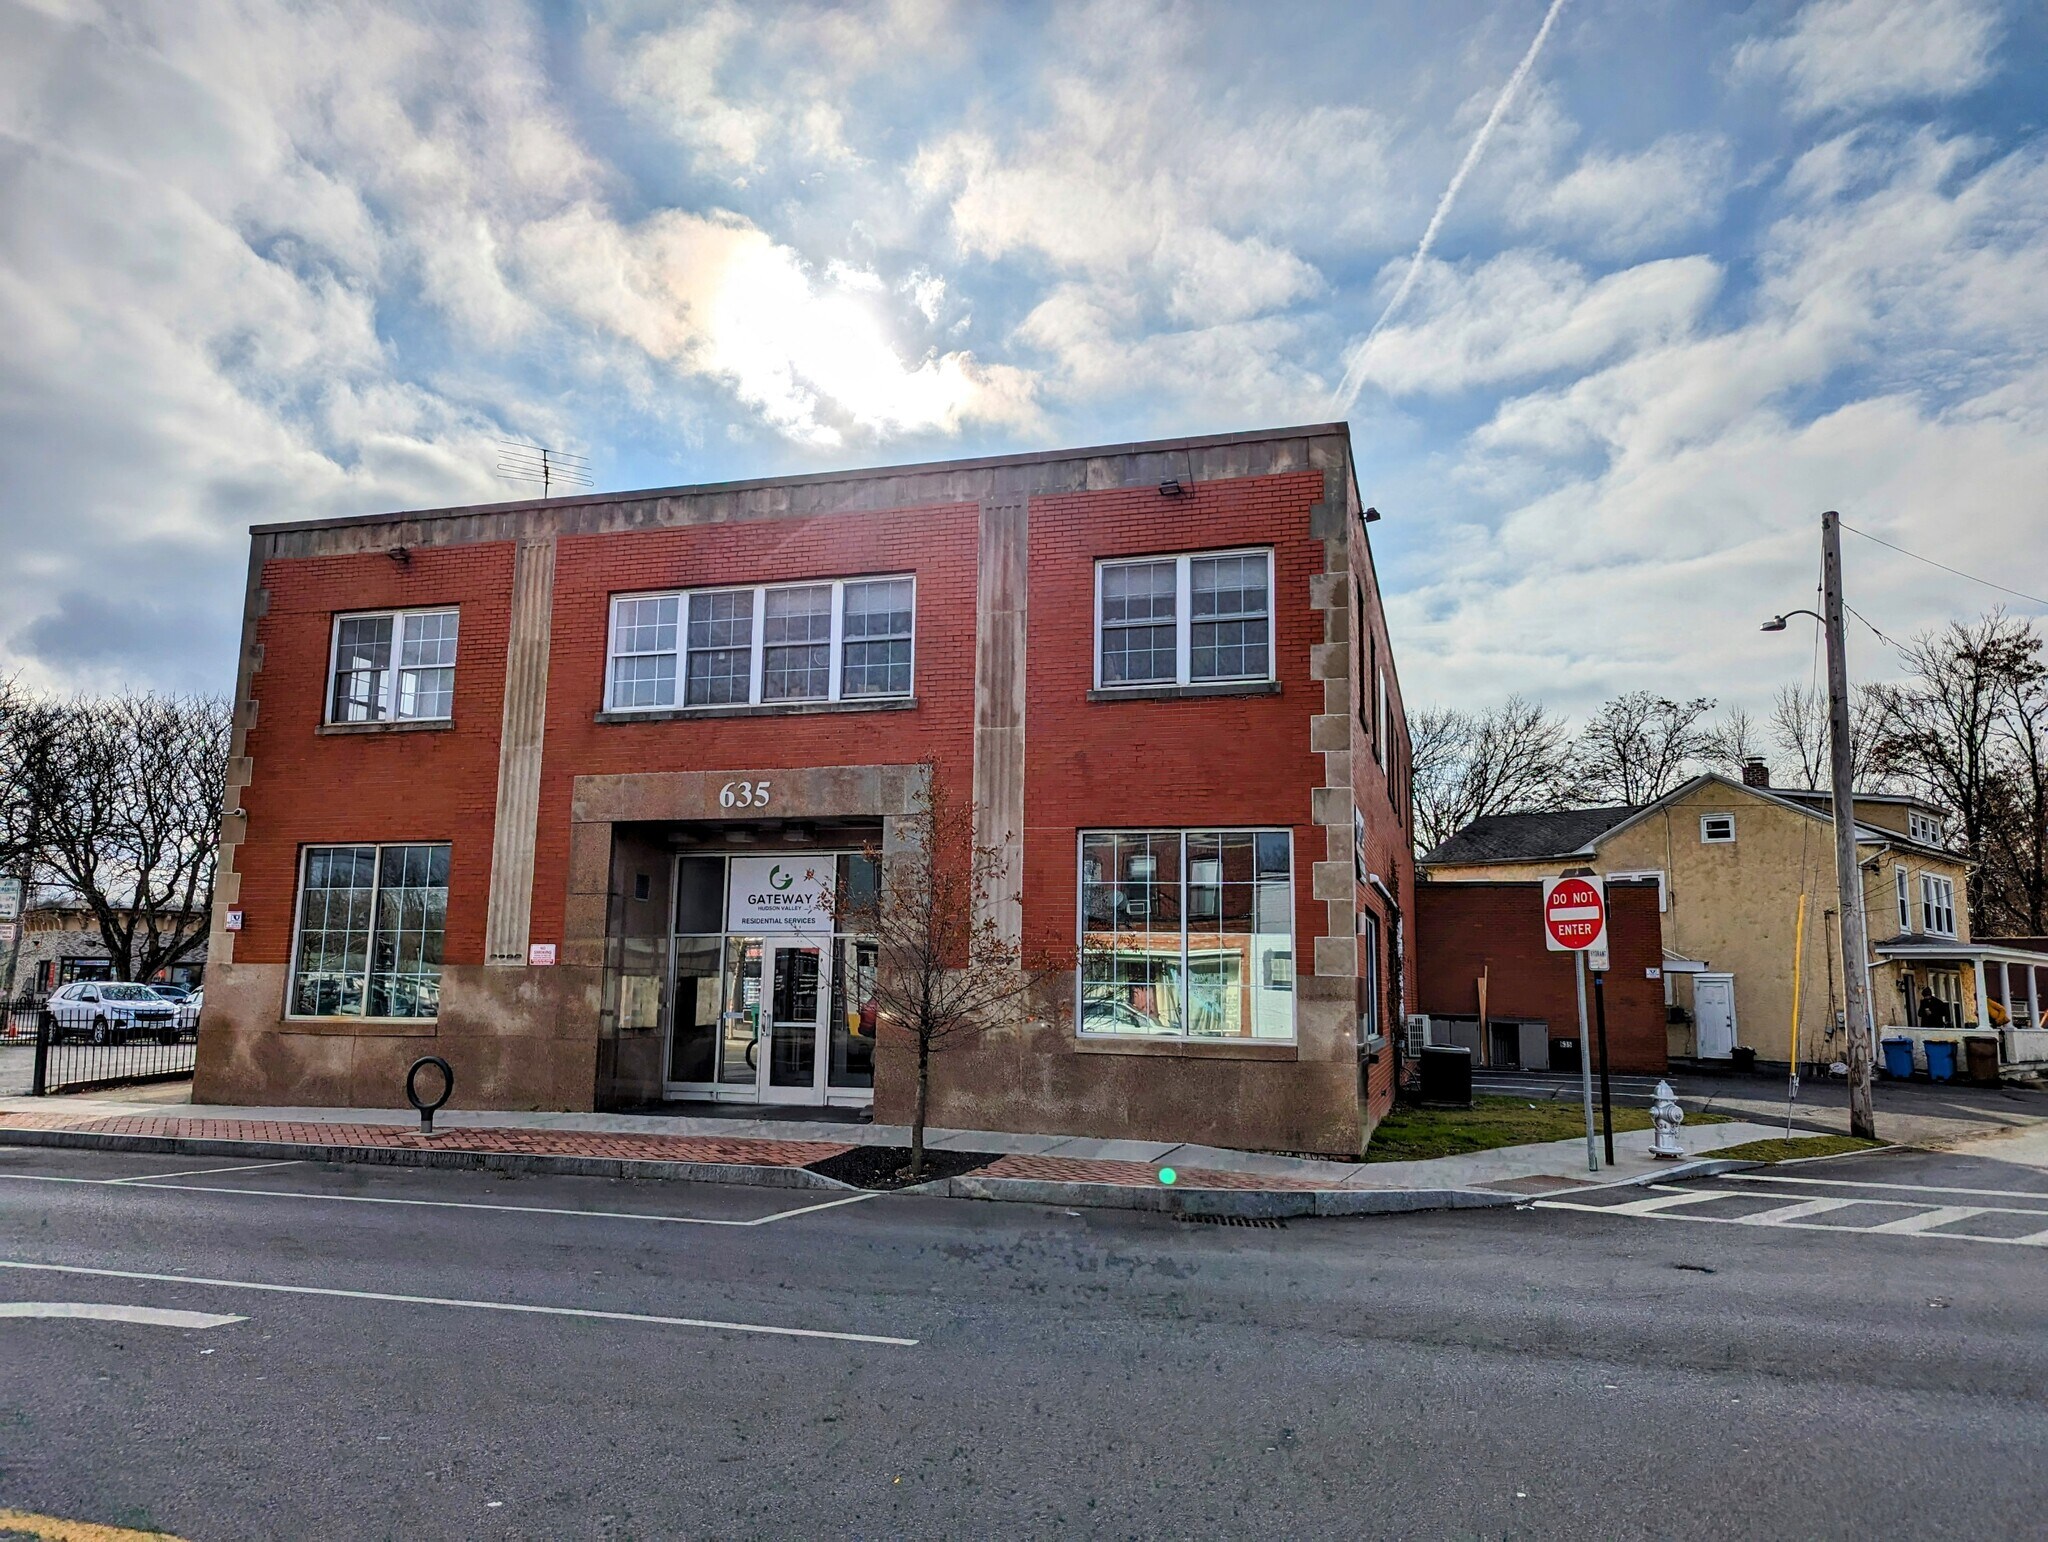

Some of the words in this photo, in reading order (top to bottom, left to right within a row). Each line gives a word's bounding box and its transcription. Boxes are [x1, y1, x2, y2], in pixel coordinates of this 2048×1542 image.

[719, 781, 770, 808] 635
[748, 893, 813, 905] GATEWAY
[1553, 893, 1567, 905] DO
[1573, 891, 1594, 903] NOT
[741, 917, 783, 925] RESIDENTIAL
[783, 917, 816, 925] SERVICES
[1558, 923, 1592, 936] ENTER
